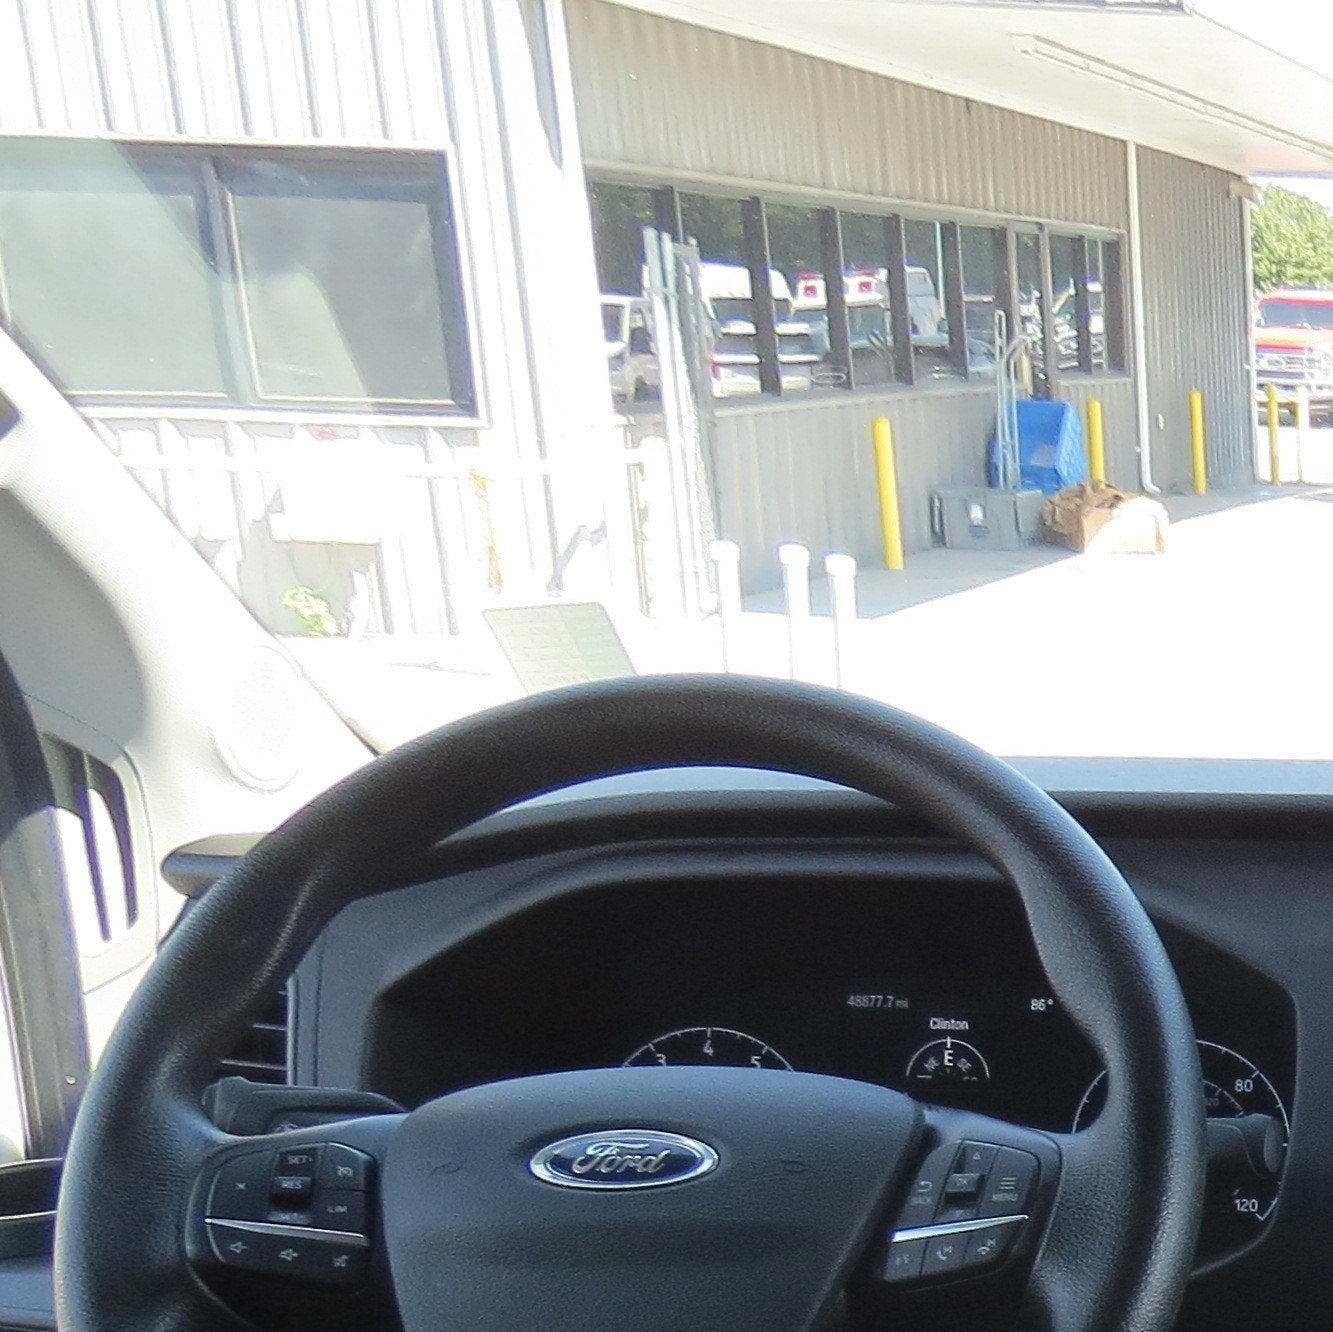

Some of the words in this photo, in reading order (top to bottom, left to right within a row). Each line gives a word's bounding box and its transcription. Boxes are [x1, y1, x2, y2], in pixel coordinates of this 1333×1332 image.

[929, 1016, 969, 1031] Clinton
[703, 1039, 714, 1057] 4
[943, 1050, 954, 1066] E
[1235, 1079, 1253, 1092] 80
[573, 1142, 670, 1175] Ford
[1235, 1198, 1258, 1212] 120
